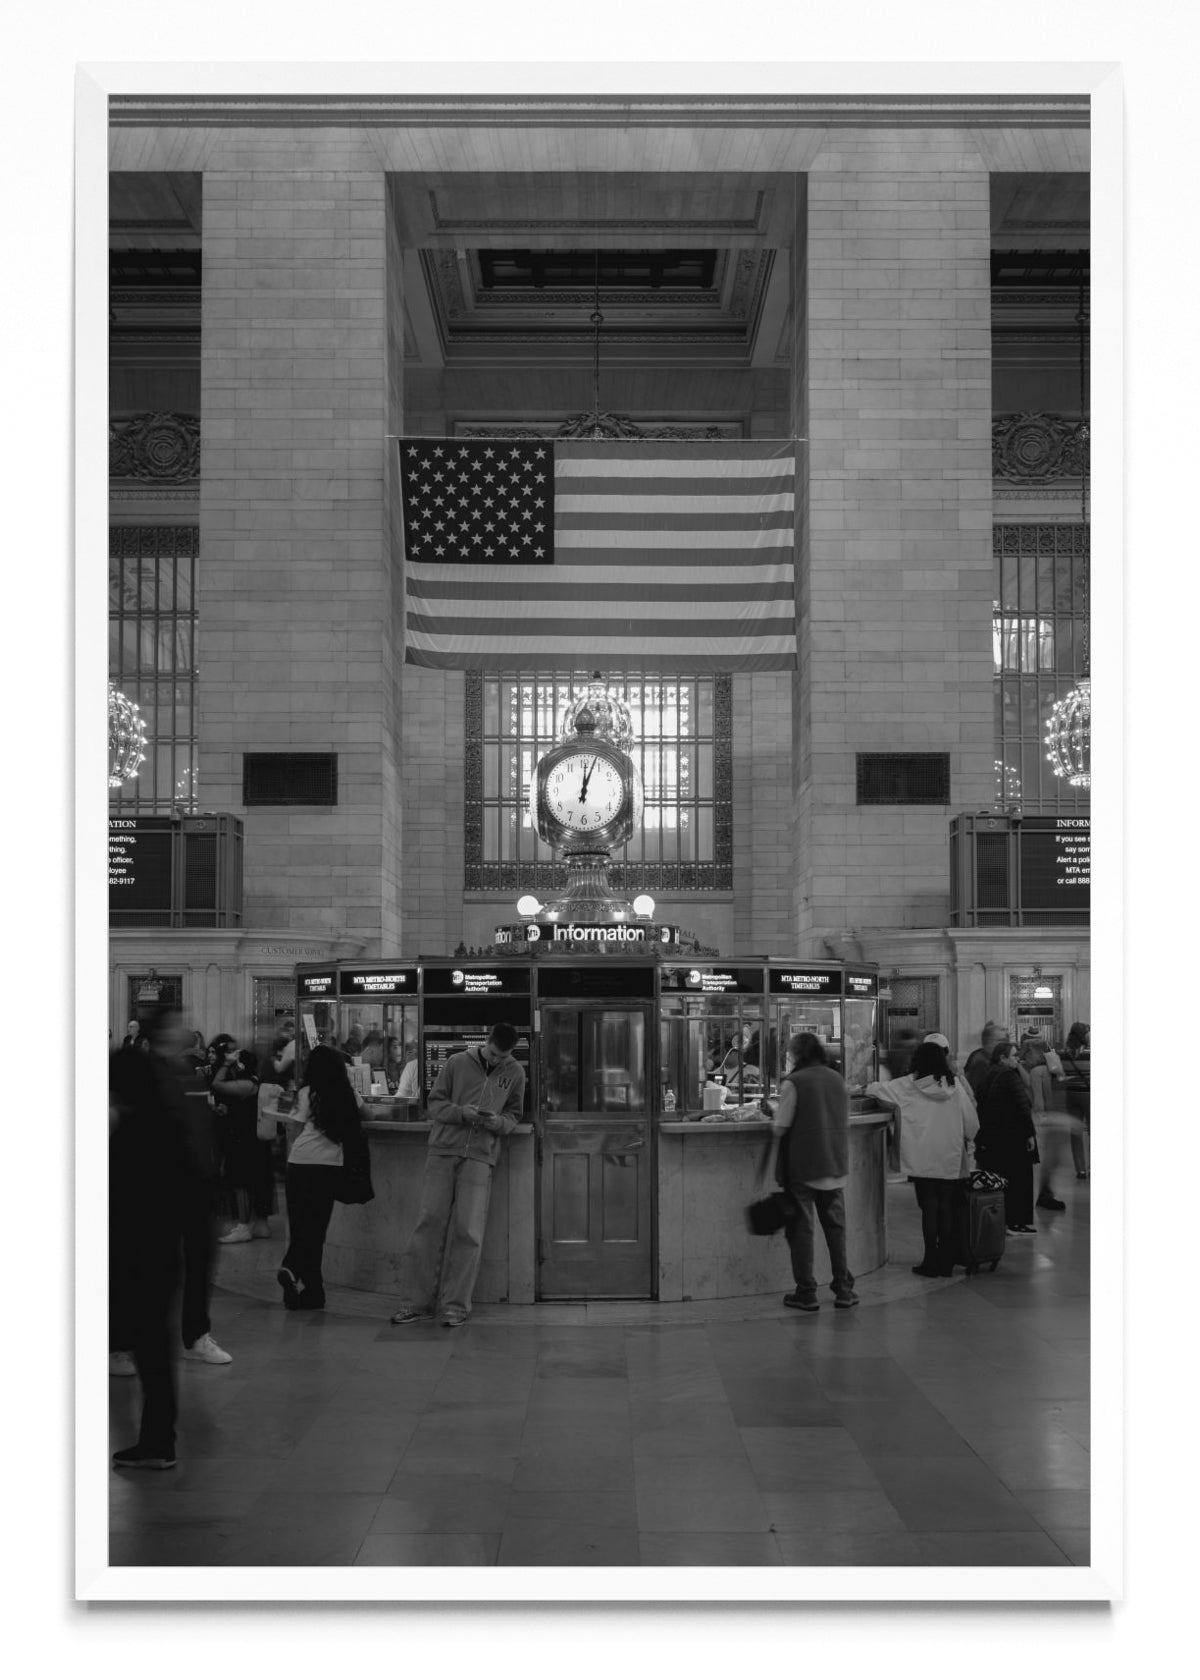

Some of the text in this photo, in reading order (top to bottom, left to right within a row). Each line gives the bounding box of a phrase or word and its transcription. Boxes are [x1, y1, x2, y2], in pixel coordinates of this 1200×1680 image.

[597, 763, 601, 773] 1
[567, 811, 573, 822] 7
[581, 815, 588, 826] 6
[594, 811, 602, 822] 5
[1061, 836, 1074, 844] you
[1065, 866, 1081, 874] MTA
[1066, 877, 1077, 885] call
[553, 924, 645, 942] Information
[781, 974, 830, 984] MTA METRO-NORTH
[498, 1076, 512, 1090] W
